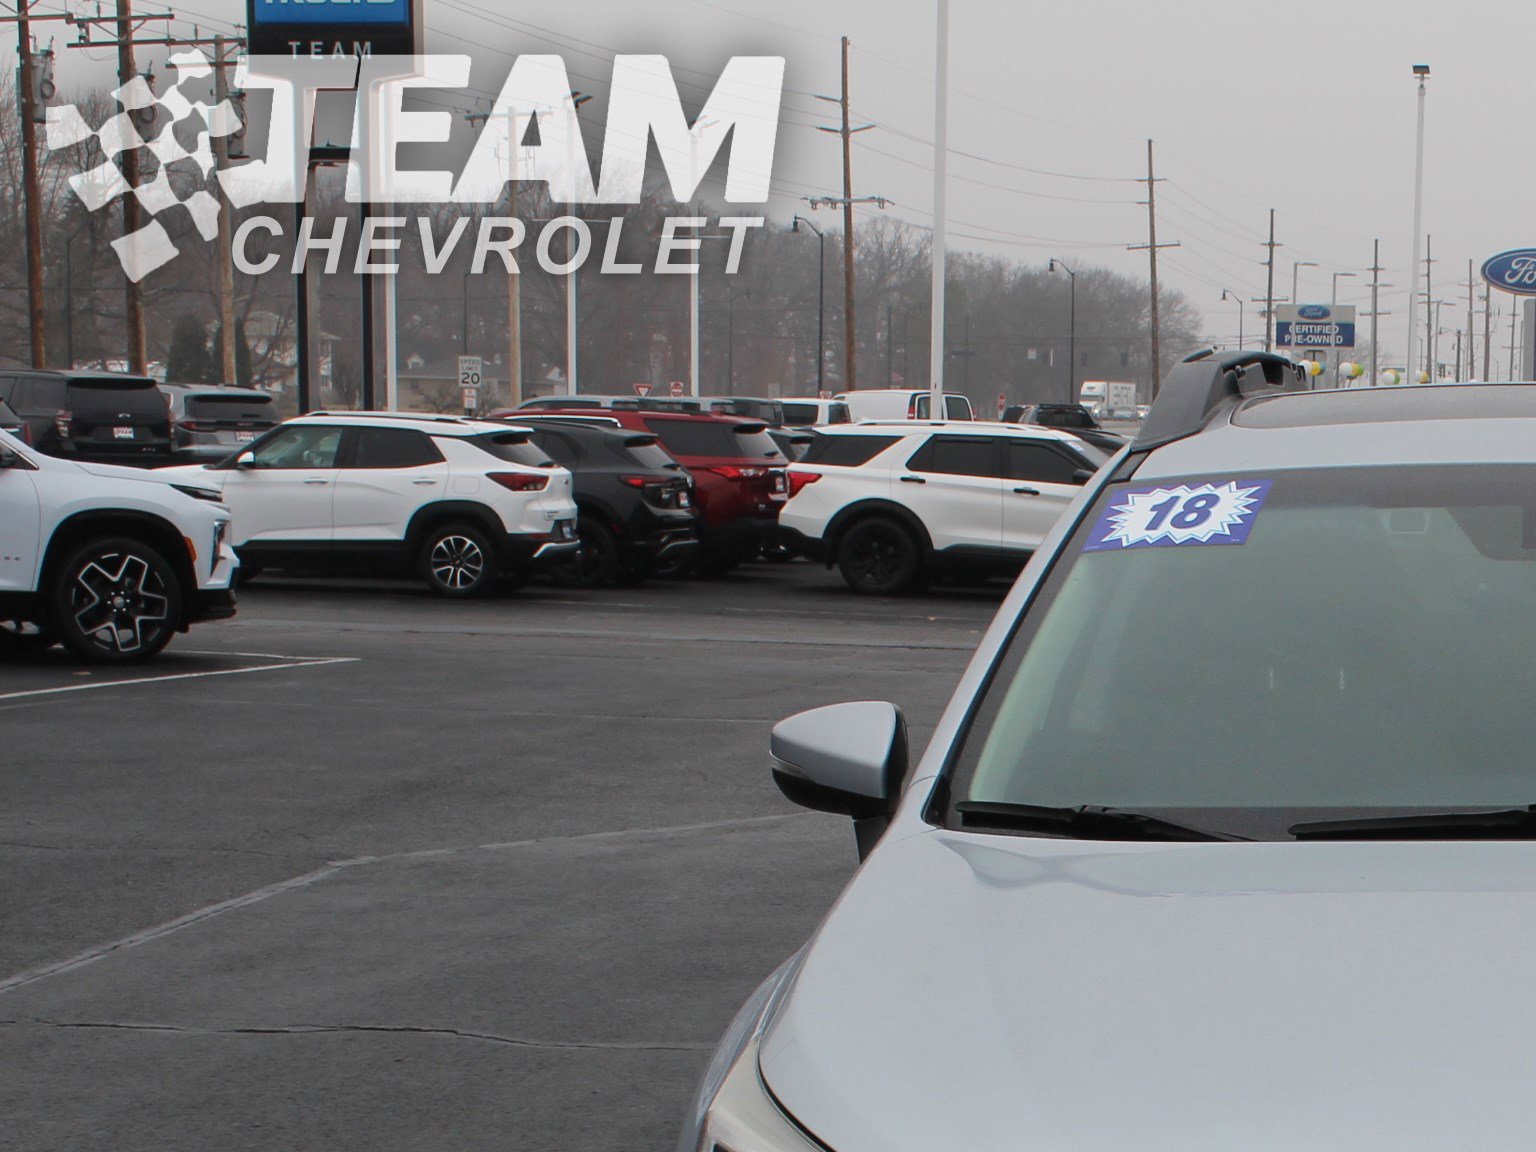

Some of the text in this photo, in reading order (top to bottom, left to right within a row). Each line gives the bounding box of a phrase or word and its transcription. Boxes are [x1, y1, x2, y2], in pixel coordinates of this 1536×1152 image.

[287, 40, 372, 60] TEAM
[1284, 334, 1344, 344] PE-OWND
[461, 372, 480, 384] 20
[1144, 493, 1222, 531] 18
